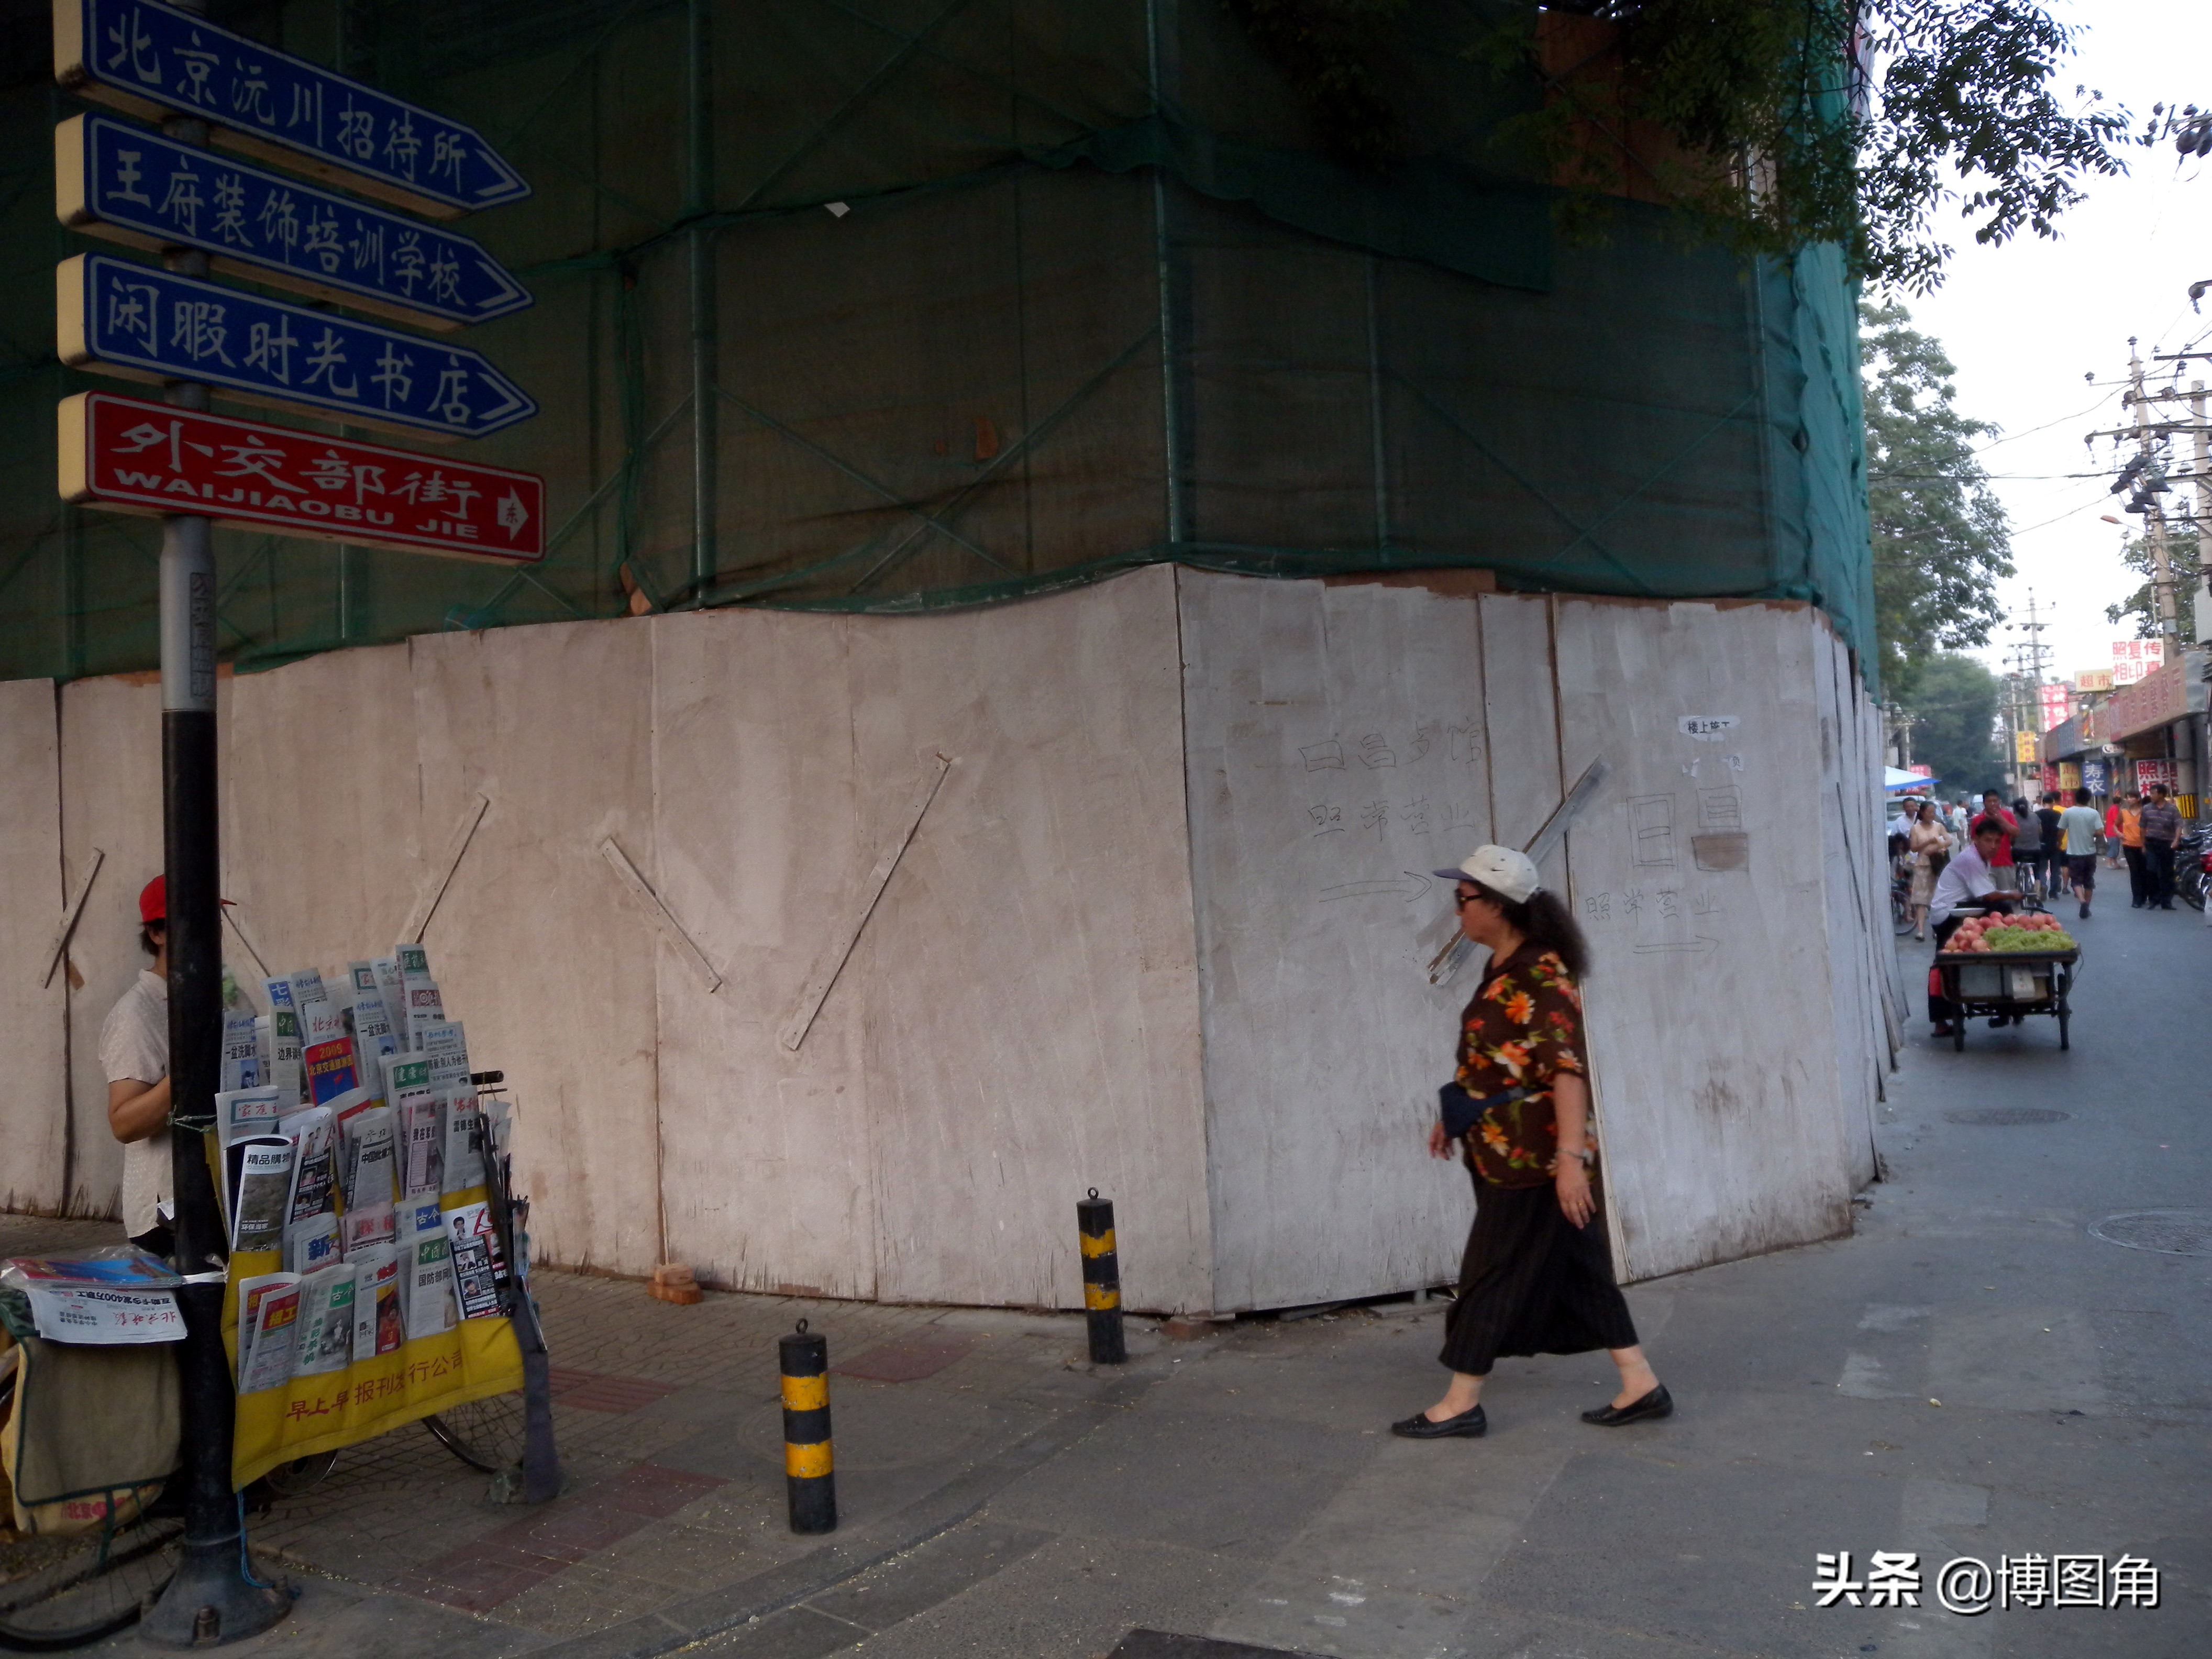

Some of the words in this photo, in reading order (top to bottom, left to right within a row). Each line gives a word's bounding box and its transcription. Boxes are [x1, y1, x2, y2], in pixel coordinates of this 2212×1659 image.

[108, 6, 468, 193] 北京沅川招待所
[107, 150, 465, 306] 王府装饰培训学校
[107, 276, 471, 424] 闲暇时光书店
[111, 422, 482, 521] 外交部街
[113, 468, 394, 526] WAIJIAOBU
[416, 518, 479, 539] JIE
[505, 503, 518, 524] 东
[2080, 674, 2110, 688] 超市
[2085, 764, 2105, 795] 寿衣
[1585, 887, 1719, 925] 照常营业
